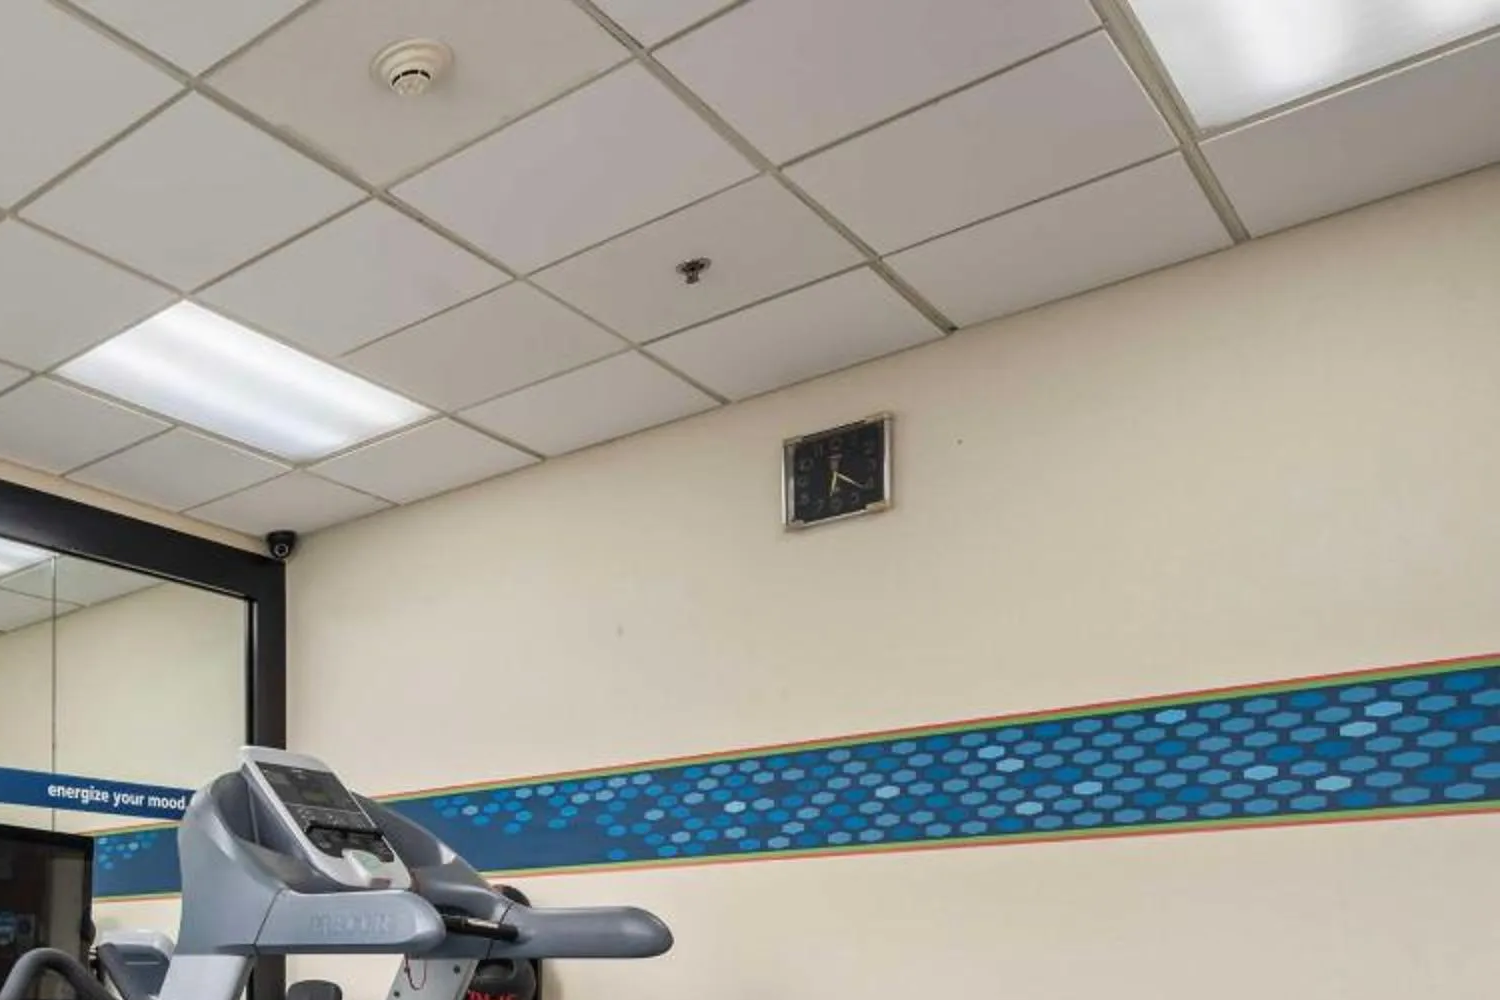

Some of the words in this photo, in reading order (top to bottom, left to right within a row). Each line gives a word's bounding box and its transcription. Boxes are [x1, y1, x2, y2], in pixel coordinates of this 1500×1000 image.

[47, 784, 109, 804] energize
[113, 791, 145, 807] your
[147, 795, 186, 810] mood
